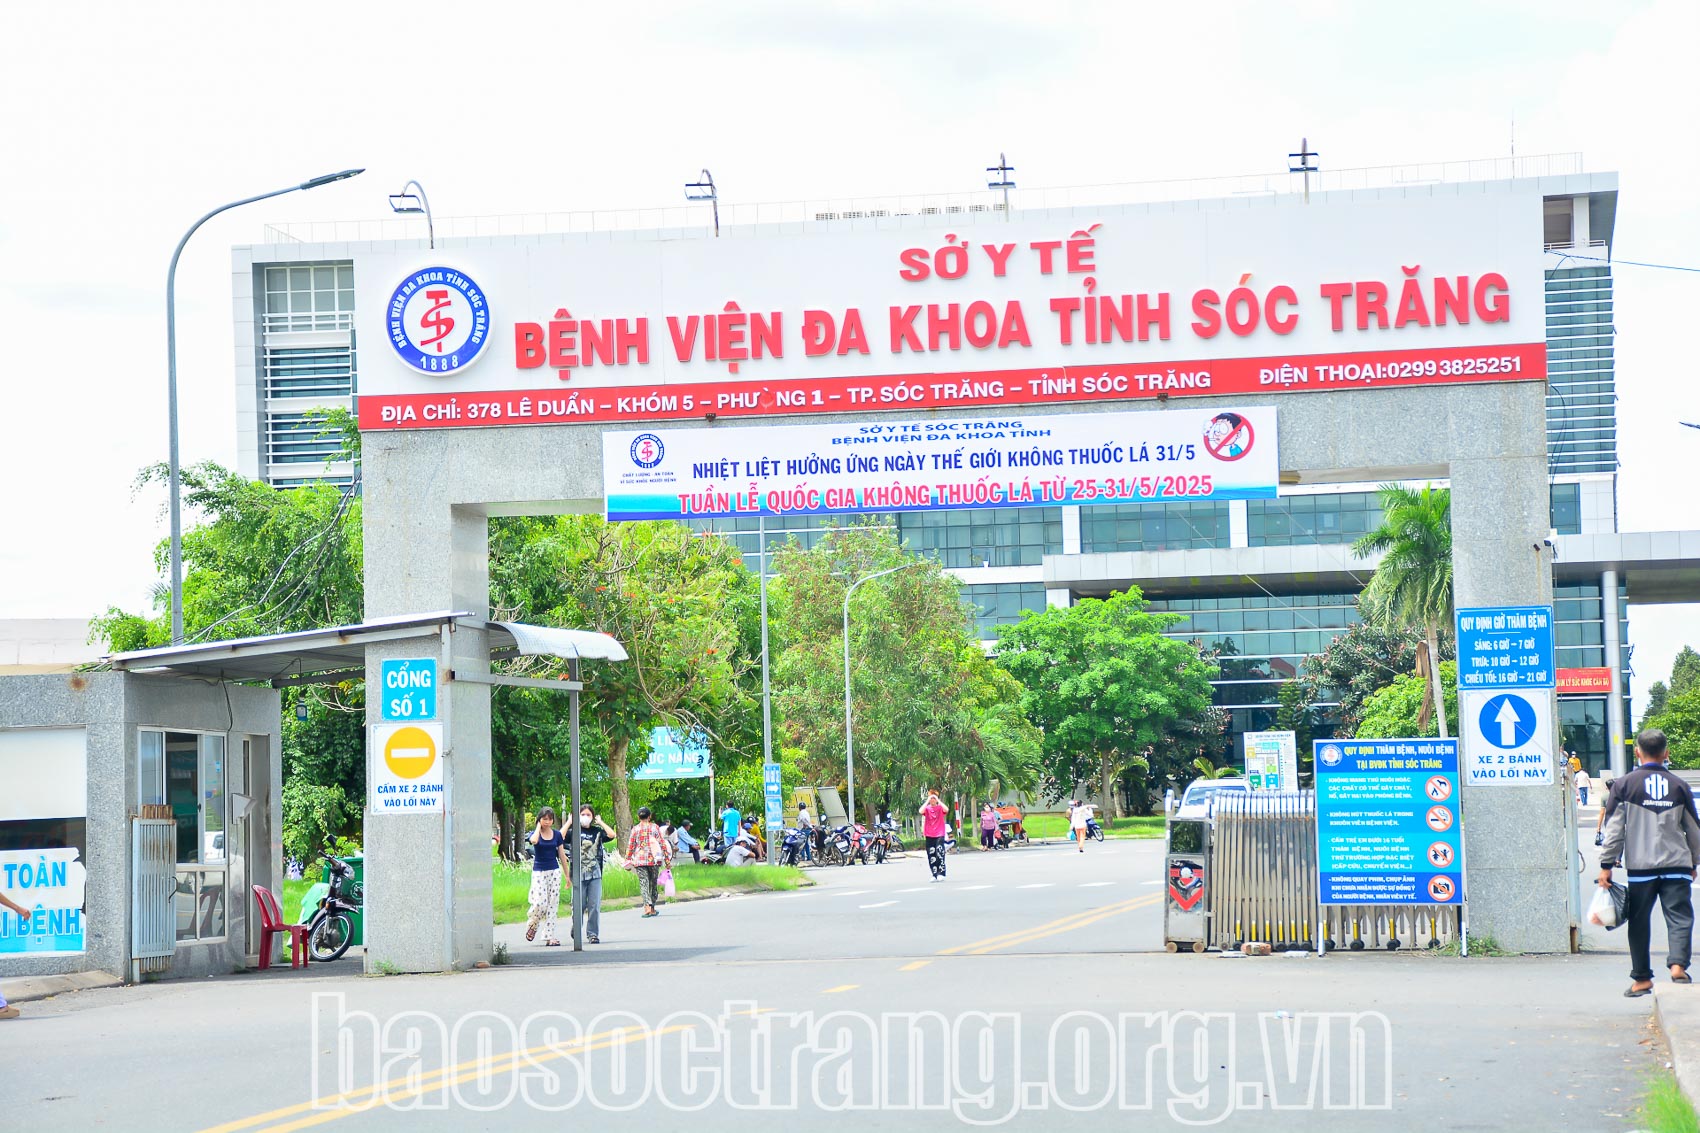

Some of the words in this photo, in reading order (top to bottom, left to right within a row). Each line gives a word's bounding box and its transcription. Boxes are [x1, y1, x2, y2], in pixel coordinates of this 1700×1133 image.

[899, 233, 969, 282] SỞ
[982, 243, 1017, 277] Y
[1030, 223, 1103, 274] TẾ
[416, 272, 443, 285] KHOA
[446, 272, 469, 290] TỈNH
[391, 294, 406, 317] VIỆN
[467, 289, 482, 308] SÓC
[472, 310, 486, 344] TRĂNG
[514, 308, 650, 381] BỆNH
[666, 300, 784, 374] VIỆN
[801, 308, 871, 357] ĐA
[889, 300, 1032, 354] KHOA
[1049, 276, 1171, 345] TỈNH
[1191, 273, 1299, 339] SÓC
[1320, 264, 1510, 332] TRĂNG
[392, 321, 407, 349] BỆNH
[420, 355, 459, 371] 1888
[1259, 364, 1308, 387] ĐIỆN
[381, 405, 417, 425] ĐỊA
[423, 398, 461, 420] CHỈ:
[467, 403, 502, 419] 378
[507, 397, 532, 418] LÊ
[538, 391, 595, 416] DUẨN
[617, 392, 678, 413] KHÓM
[682, 395, 694, 410] 5
[812, 390, 824, 405] 1
[930, 379, 1004, 400] TRĂNG
[1028, 373, 1076, 396] TỈNH
[1082, 372, 1129, 393] SÓC
[1135, 369, 1212, 391] TRĂNG
[832, 436, 878, 445] BỆNH
[883, 434, 922, 445] VIỆN
[927, 433, 951, 441] ĐA
[956, 431, 1005, 440] KHOA
[1010, 428, 1051, 438] TỈNH
[859, 424, 883, 434] SỞ
[901, 423, 920, 432] TẾ
[925, 422, 961, 431] SÓC
[963, 420, 1023, 430] TRĂNG
[693, 458, 740, 481] NHIỆT
[746, 456, 781, 480] LIỆT
[787, 453, 841, 476] HƯỞNG
[846, 453, 879, 474] ỨNG
[884, 451, 926, 472] NGÀY
[931, 446, 965, 470] THẾ
[970, 447, 1001, 468] GIỚI
[1008, 446, 1063, 467] KHÔNG
[1069, 440, 1123, 465] THUỐC
[1130, 441, 1150, 462] LÁ
[1156, 444, 1196, 462] 31/5
[678, 484, 729, 513] TUẦN
[736, 482, 759, 511] LỄ
[767, 482, 819, 514] QUỐC
[825, 488, 857, 509] GIA
[863, 481, 930, 506] KHÔNG
[936, 475, 1001, 504] THUỐC
[1008, 476, 1033, 501] LÁ
[1040, 475, 1067, 500] TỪ
[1072, 474, 1213, 499] 25-31/5/2025
[1461, 617, 1474, 632] QUY
[1476, 616, 1492, 632] ĐỊNH
[1494, 612, 1505, 629] GIỜ
[1507, 613, 1526, 628] THĂM
[1528, 611, 1547, 630] BỆNH
[1475, 638, 1492, 650] SÁNG:
[1494, 640, 1498, 650] 6
[1499, 638, 1510, 649] GIỜ
[1519, 640, 1522, 649] 7
[1524, 637, 1535, 649] GIỜ
[1471, 656, 1489, 667] TRƯA:
[1491, 657, 1498, 666] 10
[1500, 654, 1510, 666] GIỜ
[1520, 656, 1527, 665] 12
[1529, 653, 1539, 665] GIỜ
[386, 661, 431, 689] CỔNG
[1465, 670, 1483, 683] CHIỀU
[1485, 670, 1497, 683] TỐI:
[1499, 673, 1506, 682] 16
[1507, 670, 1518, 682] GIỜ
[1527, 673, 1535, 682] 21
[1536, 670, 1546, 682] GIỜ
[390, 692, 415, 717] SỐ
[419, 698, 428, 716] 1
[1344, 747, 1357, 756] QUY
[1359, 746, 1374, 756] ĐỊNH
[1376, 744, 1395, 754] THĂM
[1397, 744, 1417, 756] BỆNH,
[1418, 744, 1434, 754] NUÔI
[1436, 744, 1454, 755] BỆNH
[1478, 755, 1492, 764] XE
[1498, 755, 1505, 764] 2
[1509, 753, 1541, 764] BÁNH
[1472, 768, 1496, 779] VÀO
[1500, 766, 1521, 778] LỐI
[1524, 767, 1547, 778] NÀY
[377, 782, 397, 794] CẤM
[398, 785, 409, 794] XE
[412, 784, 418, 793] 2
[420, 783, 443, 793] BÁNH
[384, 796, 401, 807] VÀO
[403, 794, 417, 806] LỐI
[419, 795, 437, 806] NÀY
[4, 856, 66, 889] TOÀN
[17, 904, 80, 942] BỆNH
